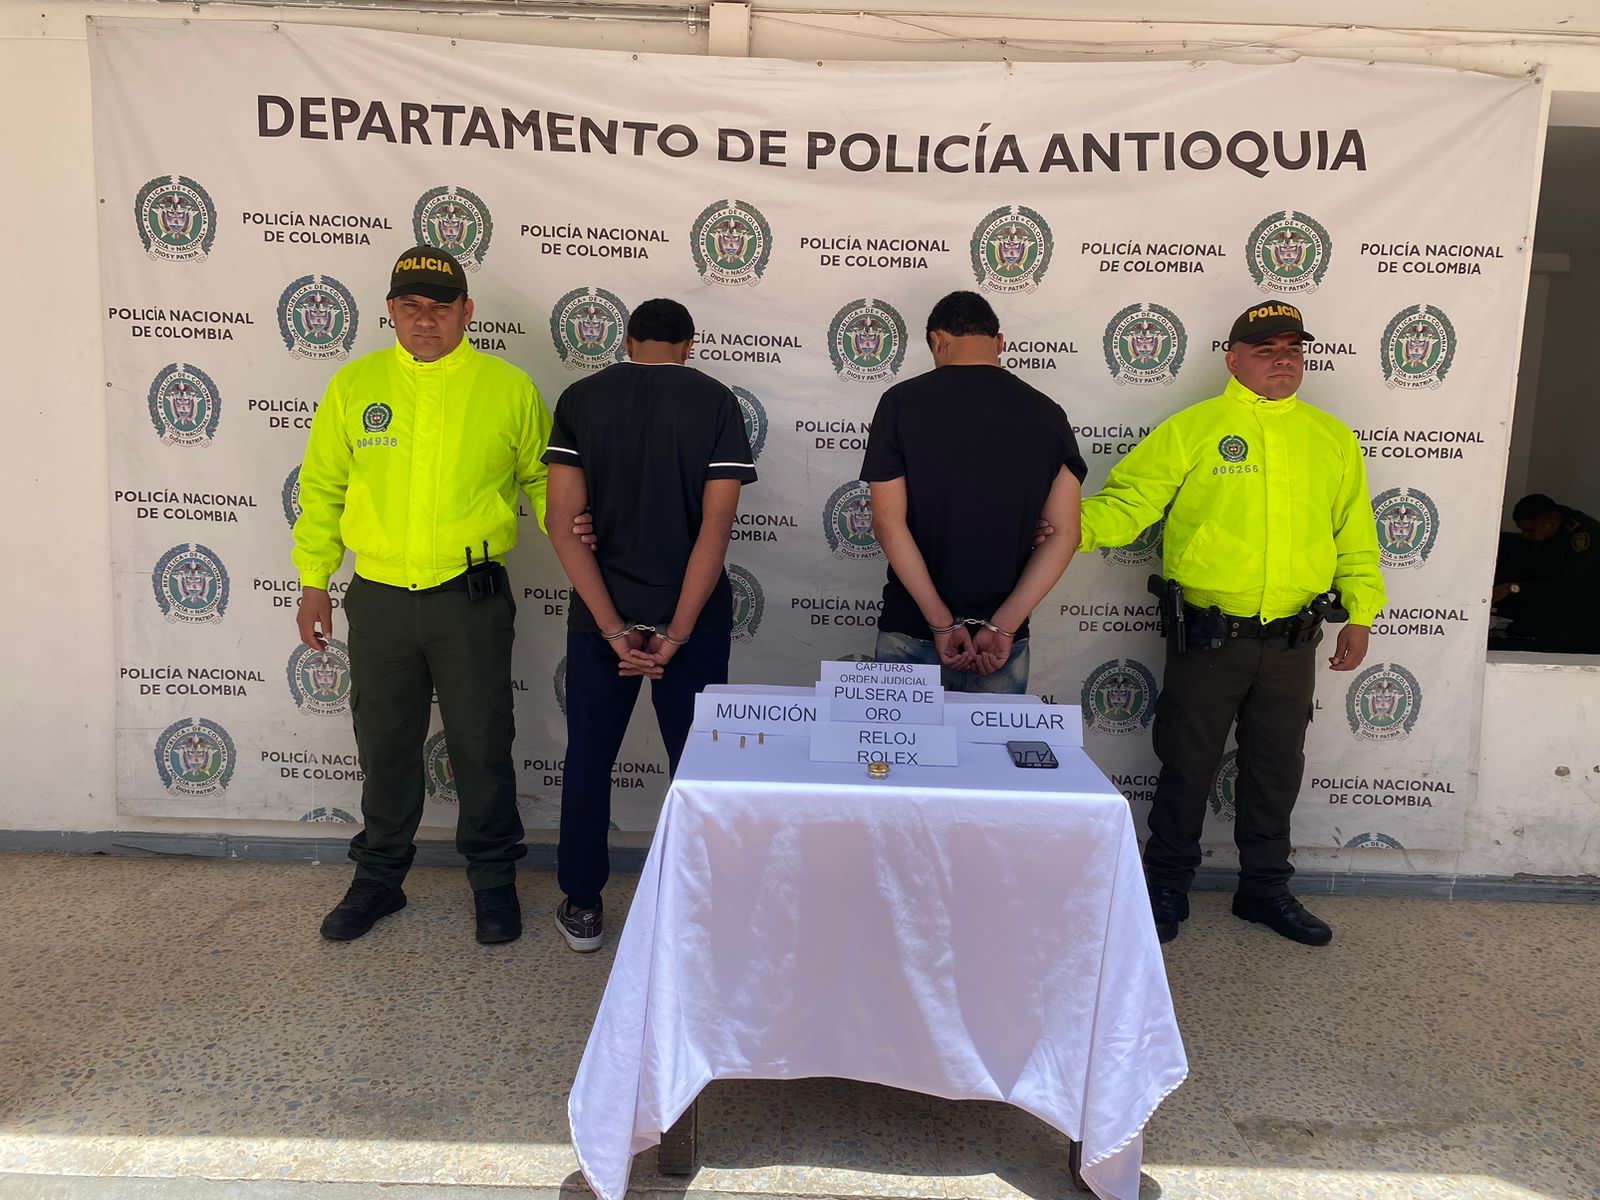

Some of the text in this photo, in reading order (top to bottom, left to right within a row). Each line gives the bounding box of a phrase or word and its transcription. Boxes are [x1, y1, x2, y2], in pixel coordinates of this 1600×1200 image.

[256, 95, 1367, 178] DEPARTAMENTO DE POLICÍA ANTIOQUIA
[242, 211, 392, 230] POLICÍA NACIONAL
[264, 231, 371, 245] DE COLOMBIA
[521, 224, 670, 242] POLICÍA NACIONAL
[800, 235, 950, 252] POLICÍA NACIONAL
[1081, 240, 1226, 256] POLICÍA NACIONAL
[1360, 242, 1504, 258] POLICÍA NACIONAL
[541, 243, 648, 259] DE COLOMBIA
[395, 257, 453, 275] POLICIA
[820, 255, 928, 269] DE COLOMBIA
[1100, 260, 1204, 273] DE COLOMBIA
[1378, 262, 1481, 275] DE COLOMBIA
[108, 306, 254, 324] POLICÍA NACIONAL
[1248, 305, 1300, 322] POLICIA
[132, 326, 233, 340] DE COLOMBIA
[464, 321, 526, 334] CIONAL
[468, 338, 506, 350] MBIA
[721, 334, 802, 348] NACIONAL
[687, 348, 781, 363] E COLOMBIA
[1302, 343, 1356, 354] IONAL
[998, 358, 1056, 369] LOMBIA
[248, 398, 309, 412] POLICÍA
[270, 417, 289, 428] DE
[796, 419, 856, 433] POLICÍA
[1352, 427, 1484, 443] OLICÍA NACIONAL
[816, 438, 835, 449] DE
[1092, 443, 1112, 454] DE
[1381, 447, 1463, 459] COLOMBIA
[114, 489, 257, 507] POLICÍA NACIONAL
[136, 508, 238, 522] DE COLOMBIA
[733, 514, 798, 527] ACIONAL
[730, 530, 777, 541] OMBIA
[254, 579, 301, 592] POLICÍ
[524, 588, 568, 600] POLIC
[273, 596, 292, 607] DE
[791, 596, 850, 610] POLICÍA
[544, 605, 563, 615] DE
[1060, 603, 1160, 616] POLICÍA NACI
[1389, 609, 1468, 621] NACIONAL
[811, 614, 877, 626] DE COLO
[1079, 621, 1162, 631] DE COLOM
[1369, 624, 1445, 635] COLOMBIA
[120, 666, 264, 682] POLICÍA NACIONAL
[855, 663, 913, 673] CAPTURAS
[840, 674, 927, 686] ORDEN JUDICIAL
[140, 684, 247, 696] DE COLOMBIA
[834, 686, 934, 703] PULSERA DE
[715, 703, 817, 722] MUNICIÓN
[865, 707, 901, 721] ORO
[970, 711, 1065, 730] CELULAR
[859, 730, 916, 745] RELOJ
[261, 750, 357, 766] POLICÍA NACI
[857, 750, 919, 766] ROLEX
[280, 767, 364, 781] DE COLOMB
[524, 760, 664, 774] POLIC IONAL
[543, 775, 644, 788] DE MBIA
[1111, 774, 1158, 786] NACIO
[1311, 776, 1456, 793] POLICÍA NACIONAL
[1329, 793, 1433, 807] DE COLOMBIA
